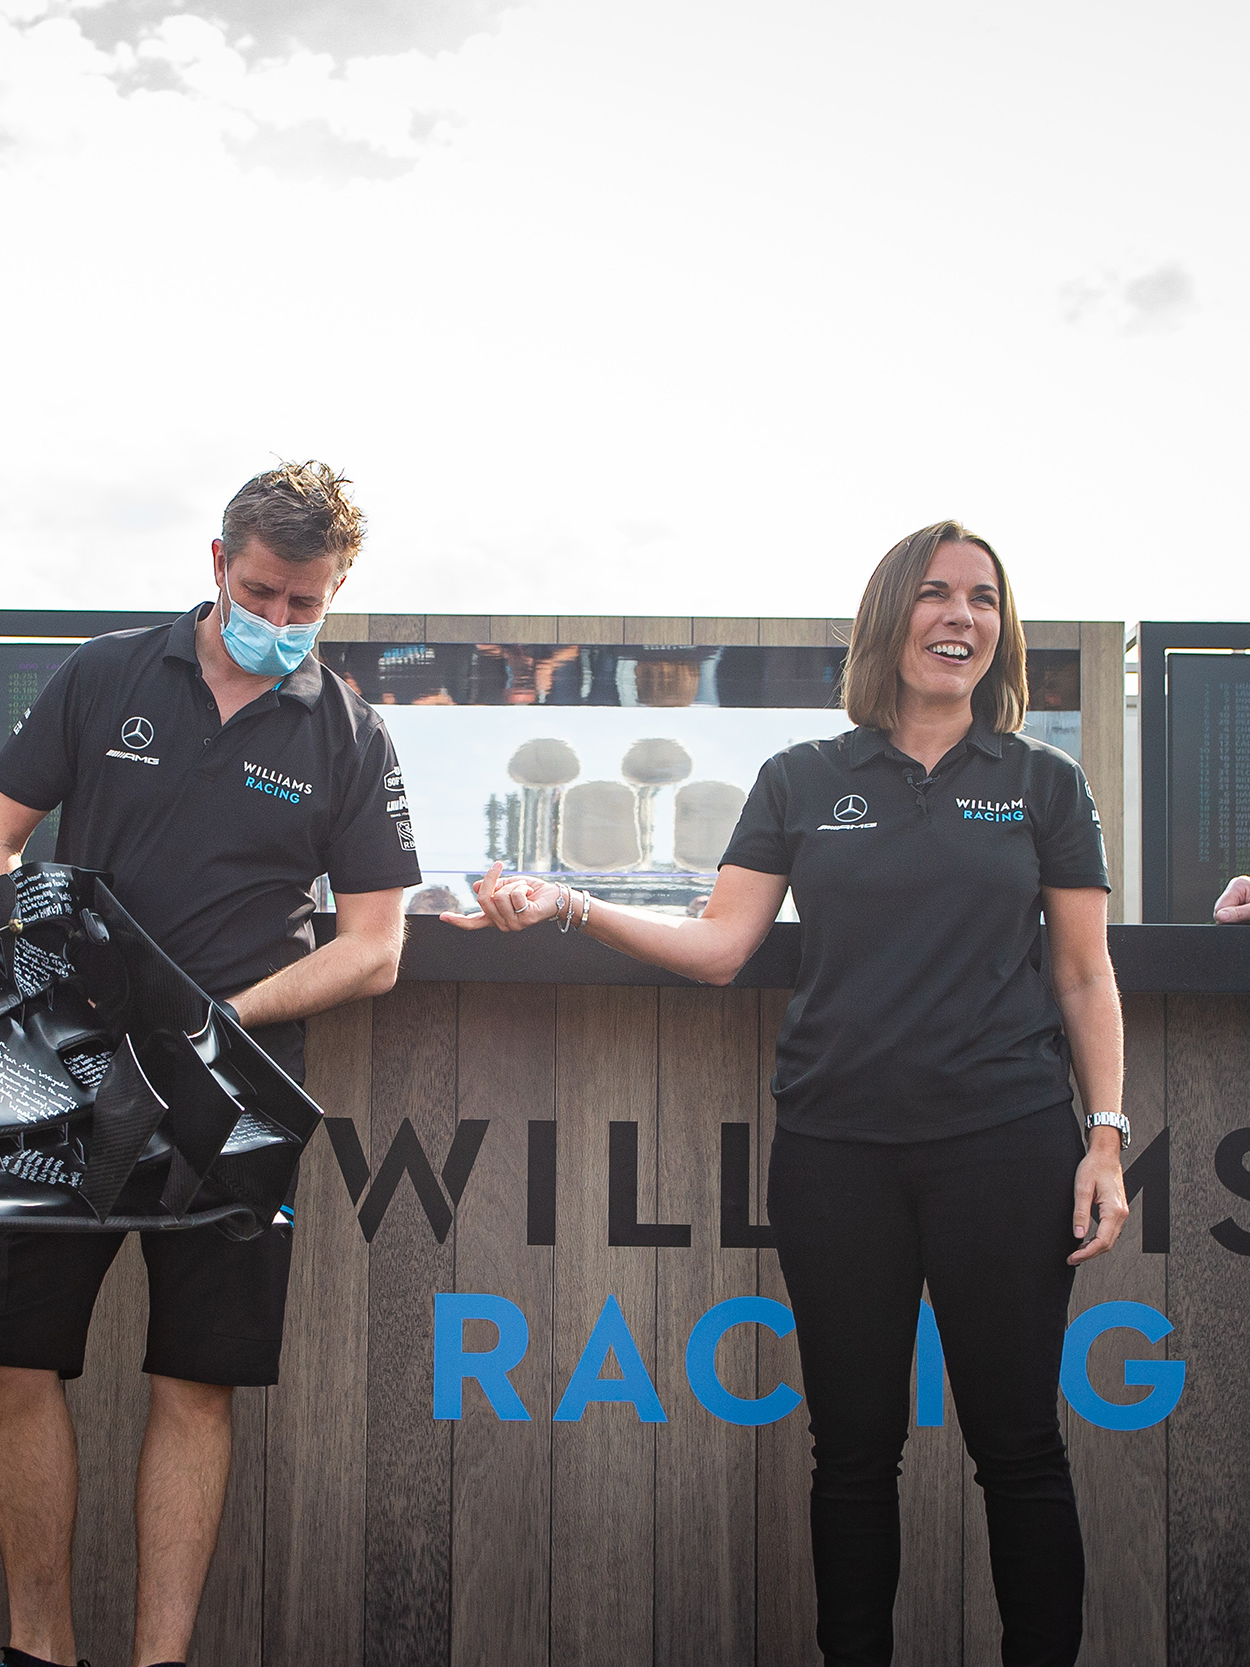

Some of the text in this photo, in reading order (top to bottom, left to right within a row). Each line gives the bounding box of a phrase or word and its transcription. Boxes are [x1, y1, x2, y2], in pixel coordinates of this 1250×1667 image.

[119, 752, 160, 765] AMG
[243, 761, 313, 795] WILLIAMS
[245, 776, 300, 804] RACING
[956, 797, 1028, 812] WILLIAM
[963, 810, 1025, 822] RACING
[434, 1293, 1186, 1431] RACIG
